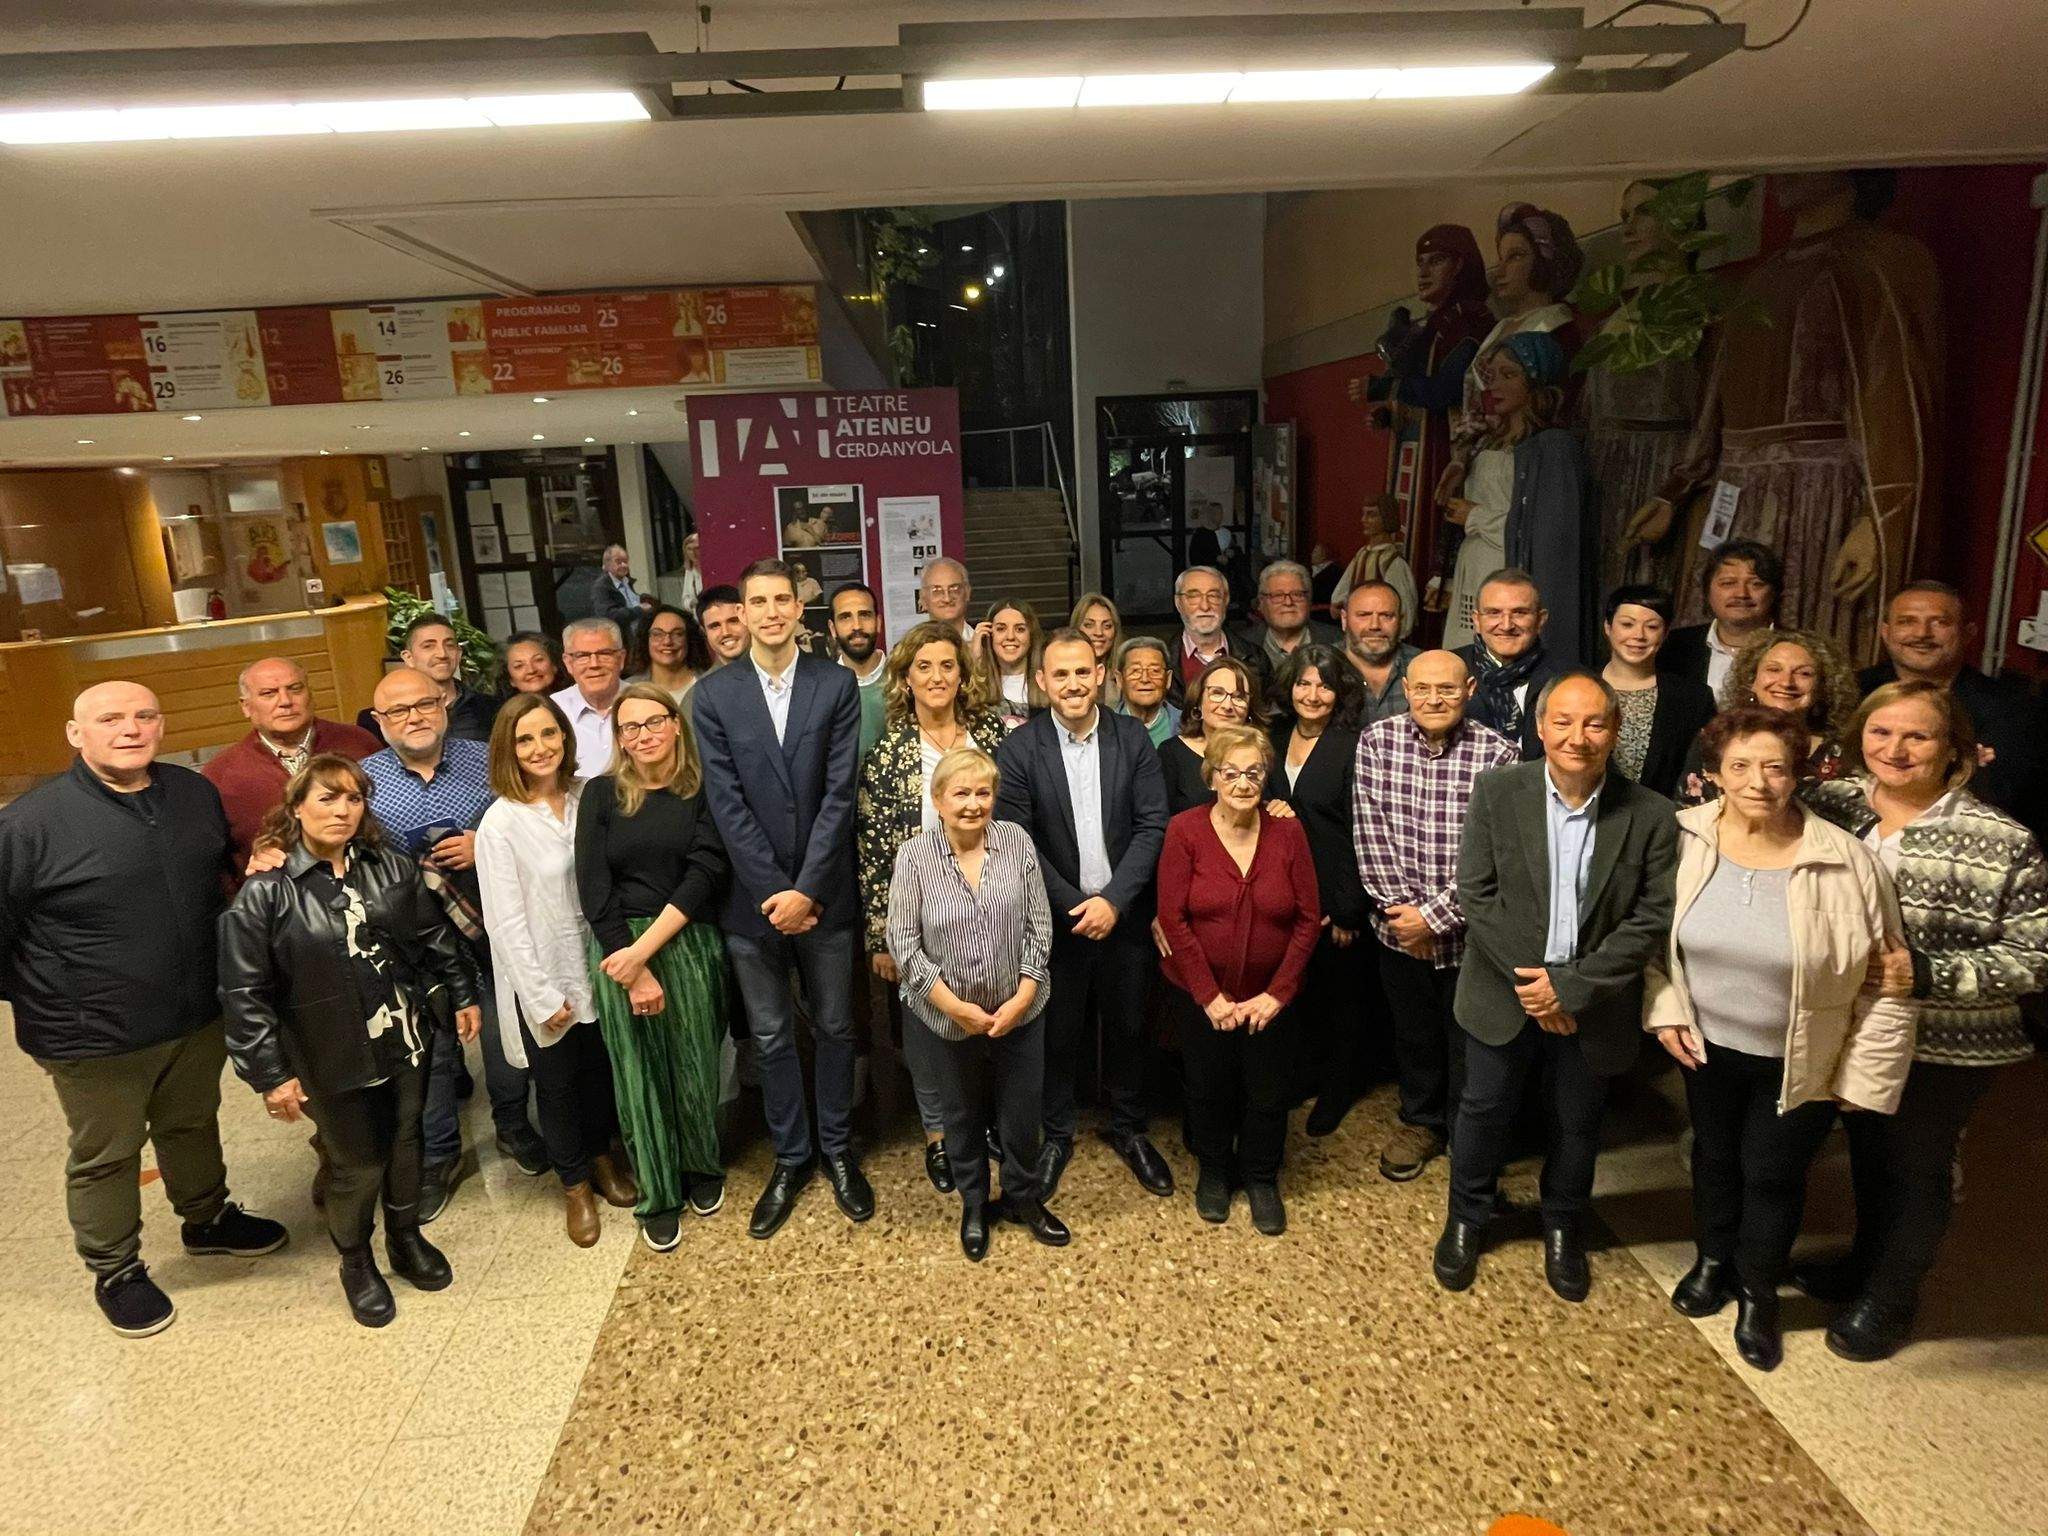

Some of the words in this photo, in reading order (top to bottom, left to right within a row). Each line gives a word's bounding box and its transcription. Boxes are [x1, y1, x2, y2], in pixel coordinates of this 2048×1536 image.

[497, 304, 580, 317] PROGRAMACIÓ
[598, 309, 618, 328] 25
[705, 305, 727, 324] 26
[378, 320, 396, 336] 14
[535, 325, 588, 336] FAMILIAR
[146, 336, 167, 352] 16
[492, 363, 515, 381] 22
[602, 356, 624, 375] 26
[385, 370, 404, 385] 26
[154, 381, 175, 398] 29
[834, 395, 908, 414] TEATRE
[836, 416, 931, 437] ATENEU
[837, 440, 954, 458] CERDANYOLA
